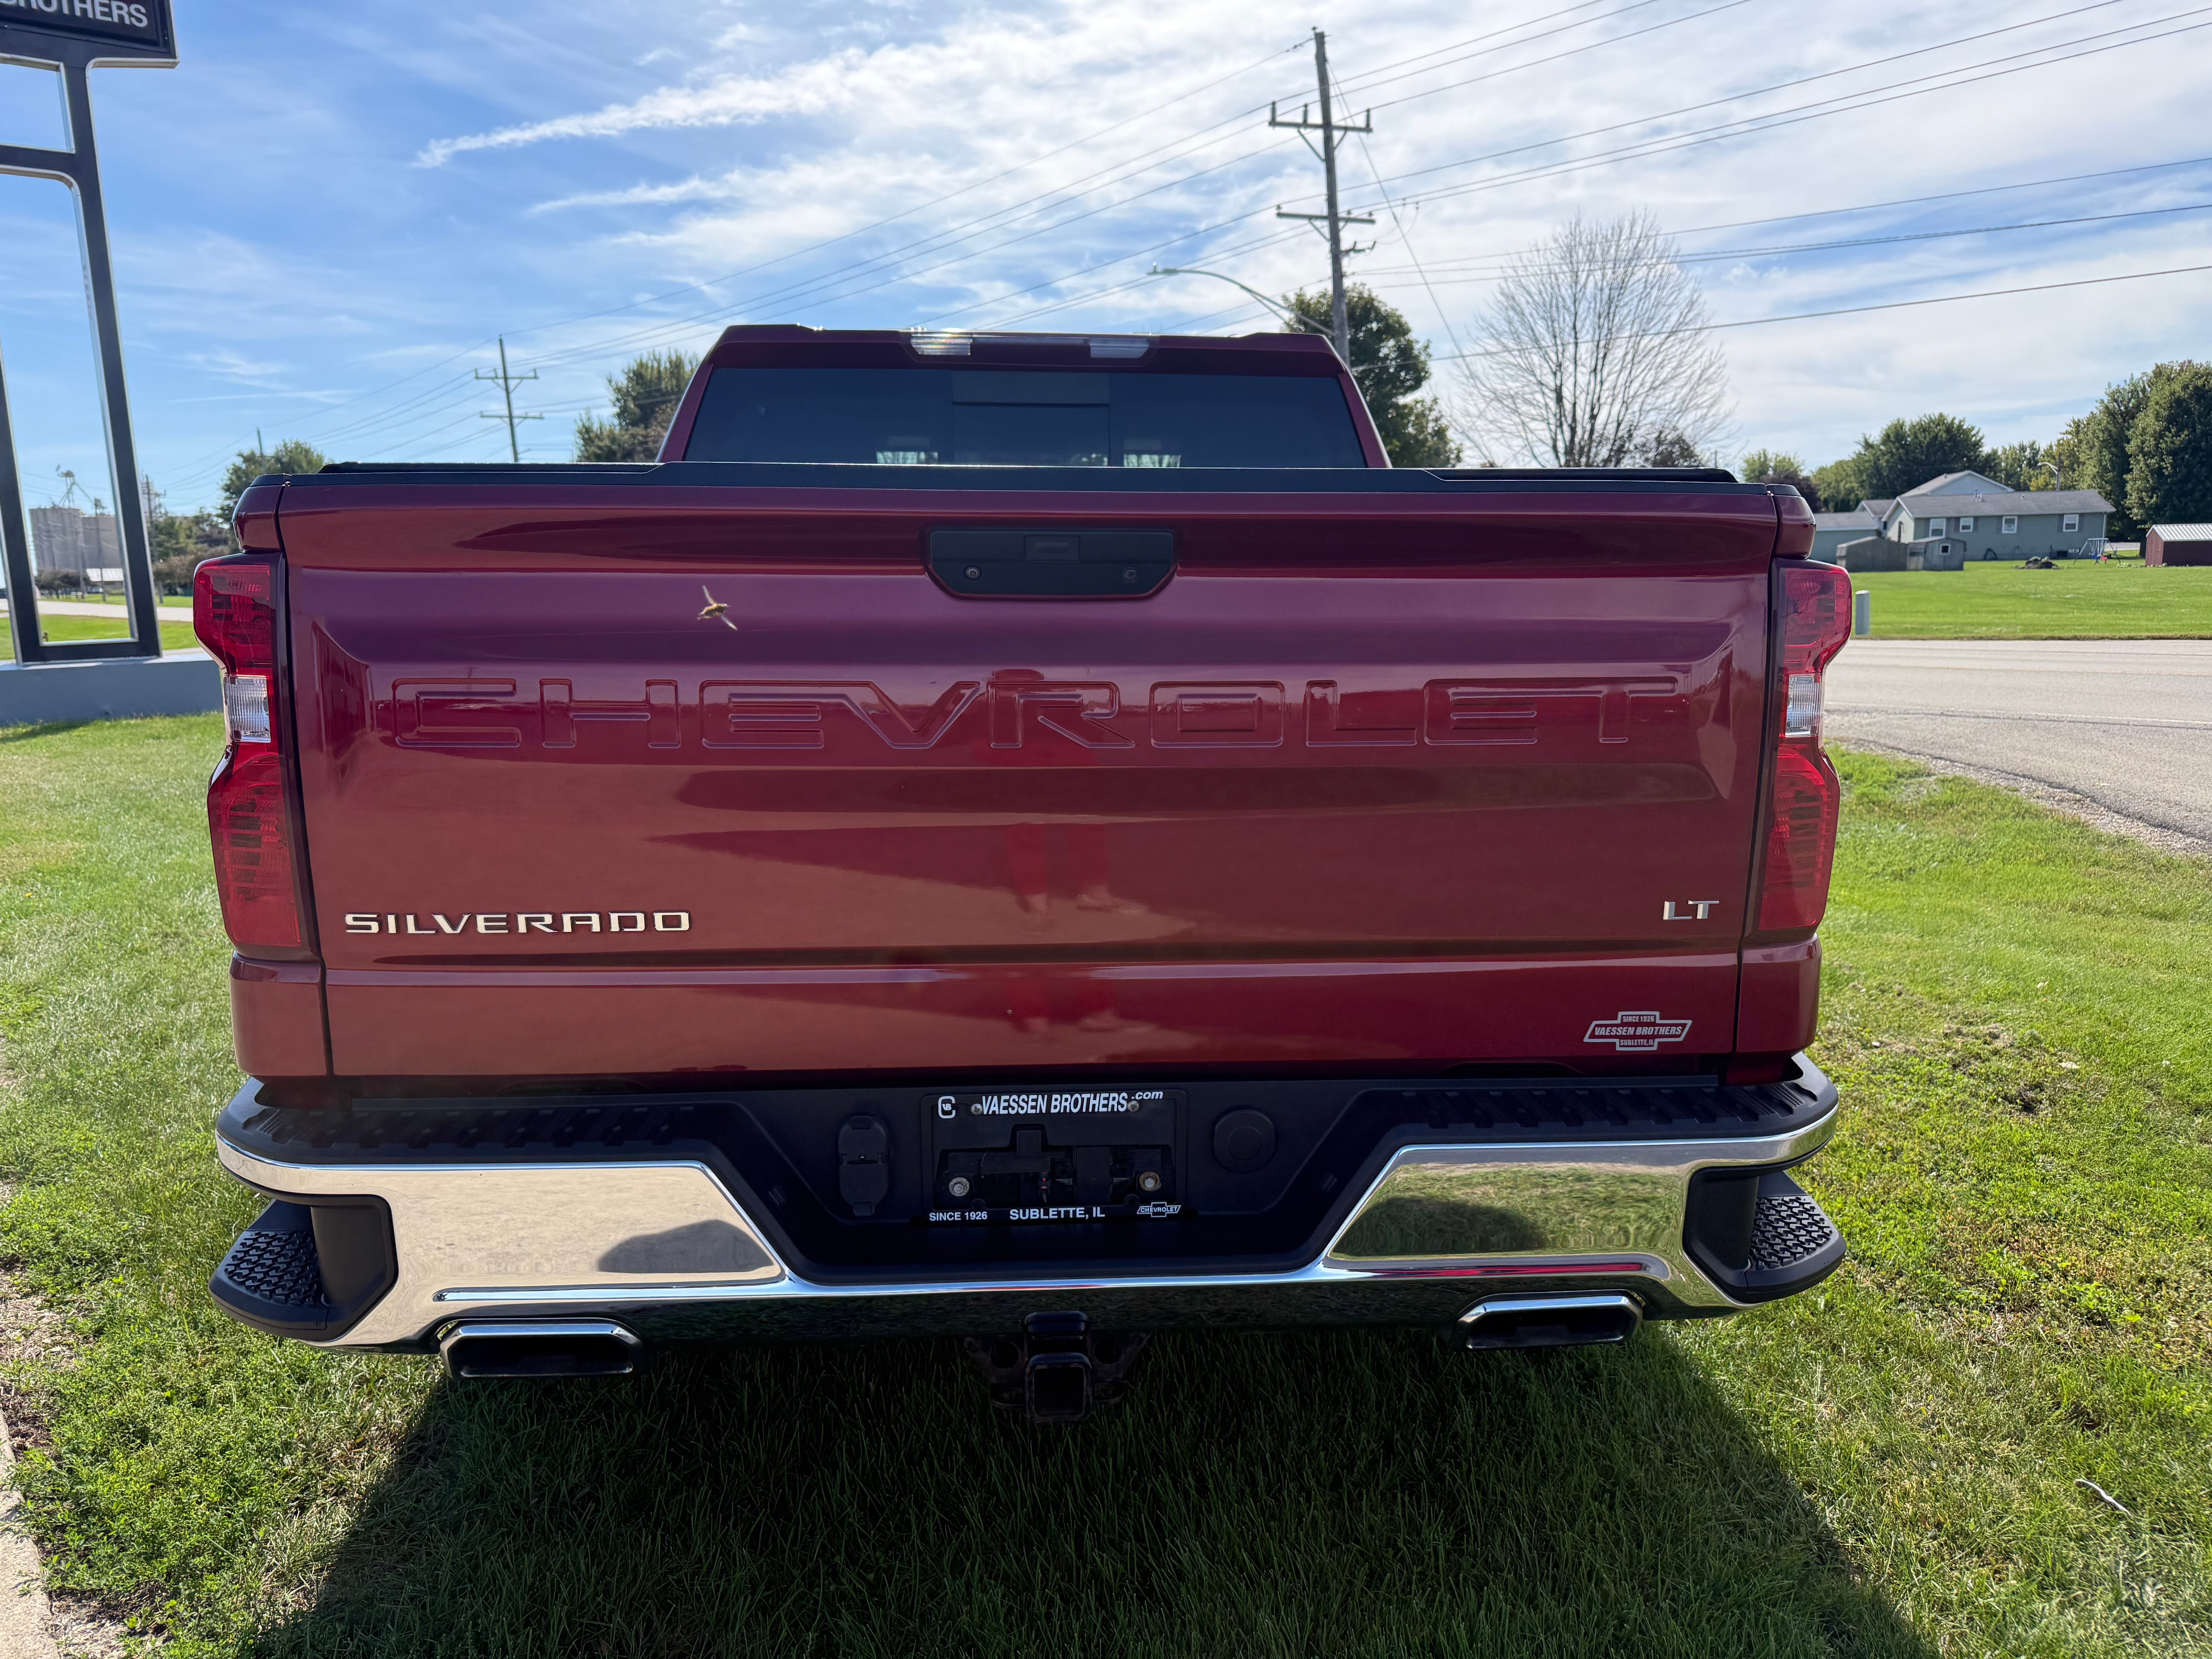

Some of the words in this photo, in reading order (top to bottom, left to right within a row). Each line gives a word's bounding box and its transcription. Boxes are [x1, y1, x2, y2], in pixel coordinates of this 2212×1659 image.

[391, 677, 1679, 750] CHEVROLET
[1663, 900, 1719, 920] LT
[344, 912, 692, 934] SILVERADO
[1594, 1027, 1635, 1036] VAESSEN
[1635, 1026, 1683, 1035] BROTHERS
[982, 1094, 1048, 1115] VAESSEN
[1050, 1092, 1128, 1113] BROTHERS
[1131, 1091, 1163, 1100] .com
[929, 1212, 961, 1221] SINCE
[964, 1211, 988, 1220] 1926
[1010, 1207, 1089, 1220] SUBLETTE,
[1092, 1207, 1105, 1217] IL
